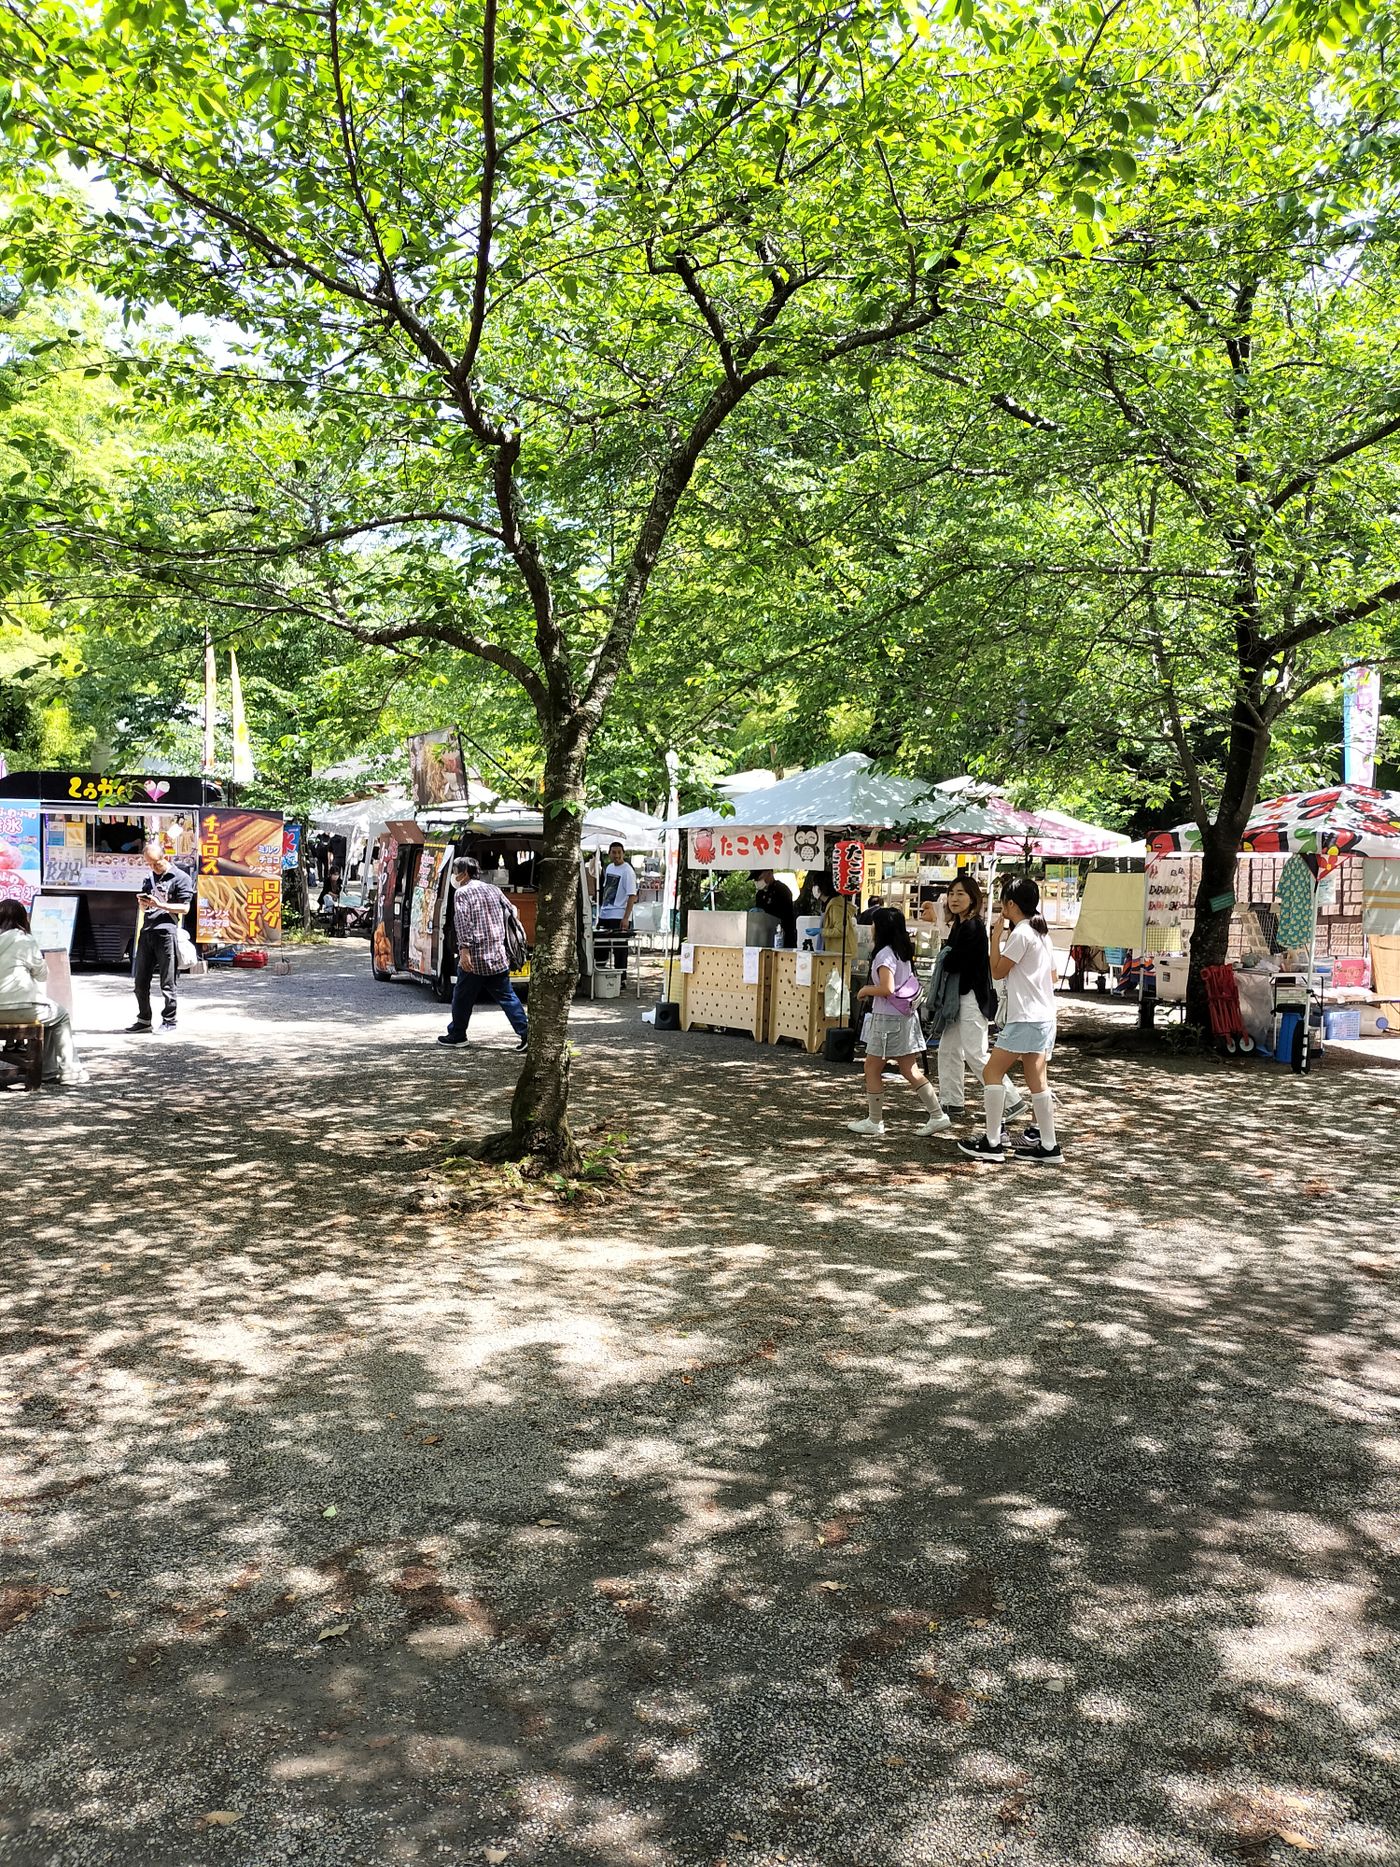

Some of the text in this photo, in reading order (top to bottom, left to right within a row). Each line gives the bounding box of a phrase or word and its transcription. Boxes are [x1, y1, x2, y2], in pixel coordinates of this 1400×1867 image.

[203, 814, 220, 874] チュロス
[258, 845, 280, 854] ミルク
[720, 832, 784, 856] たこやき
[259, 856, 280, 865] チョコ
[249, 865, 280, 874] シナモン
[264, 880, 280, 928] ロング
[200, 909, 230, 917] コンソメ
[247, 888, 263, 937] ポテト
